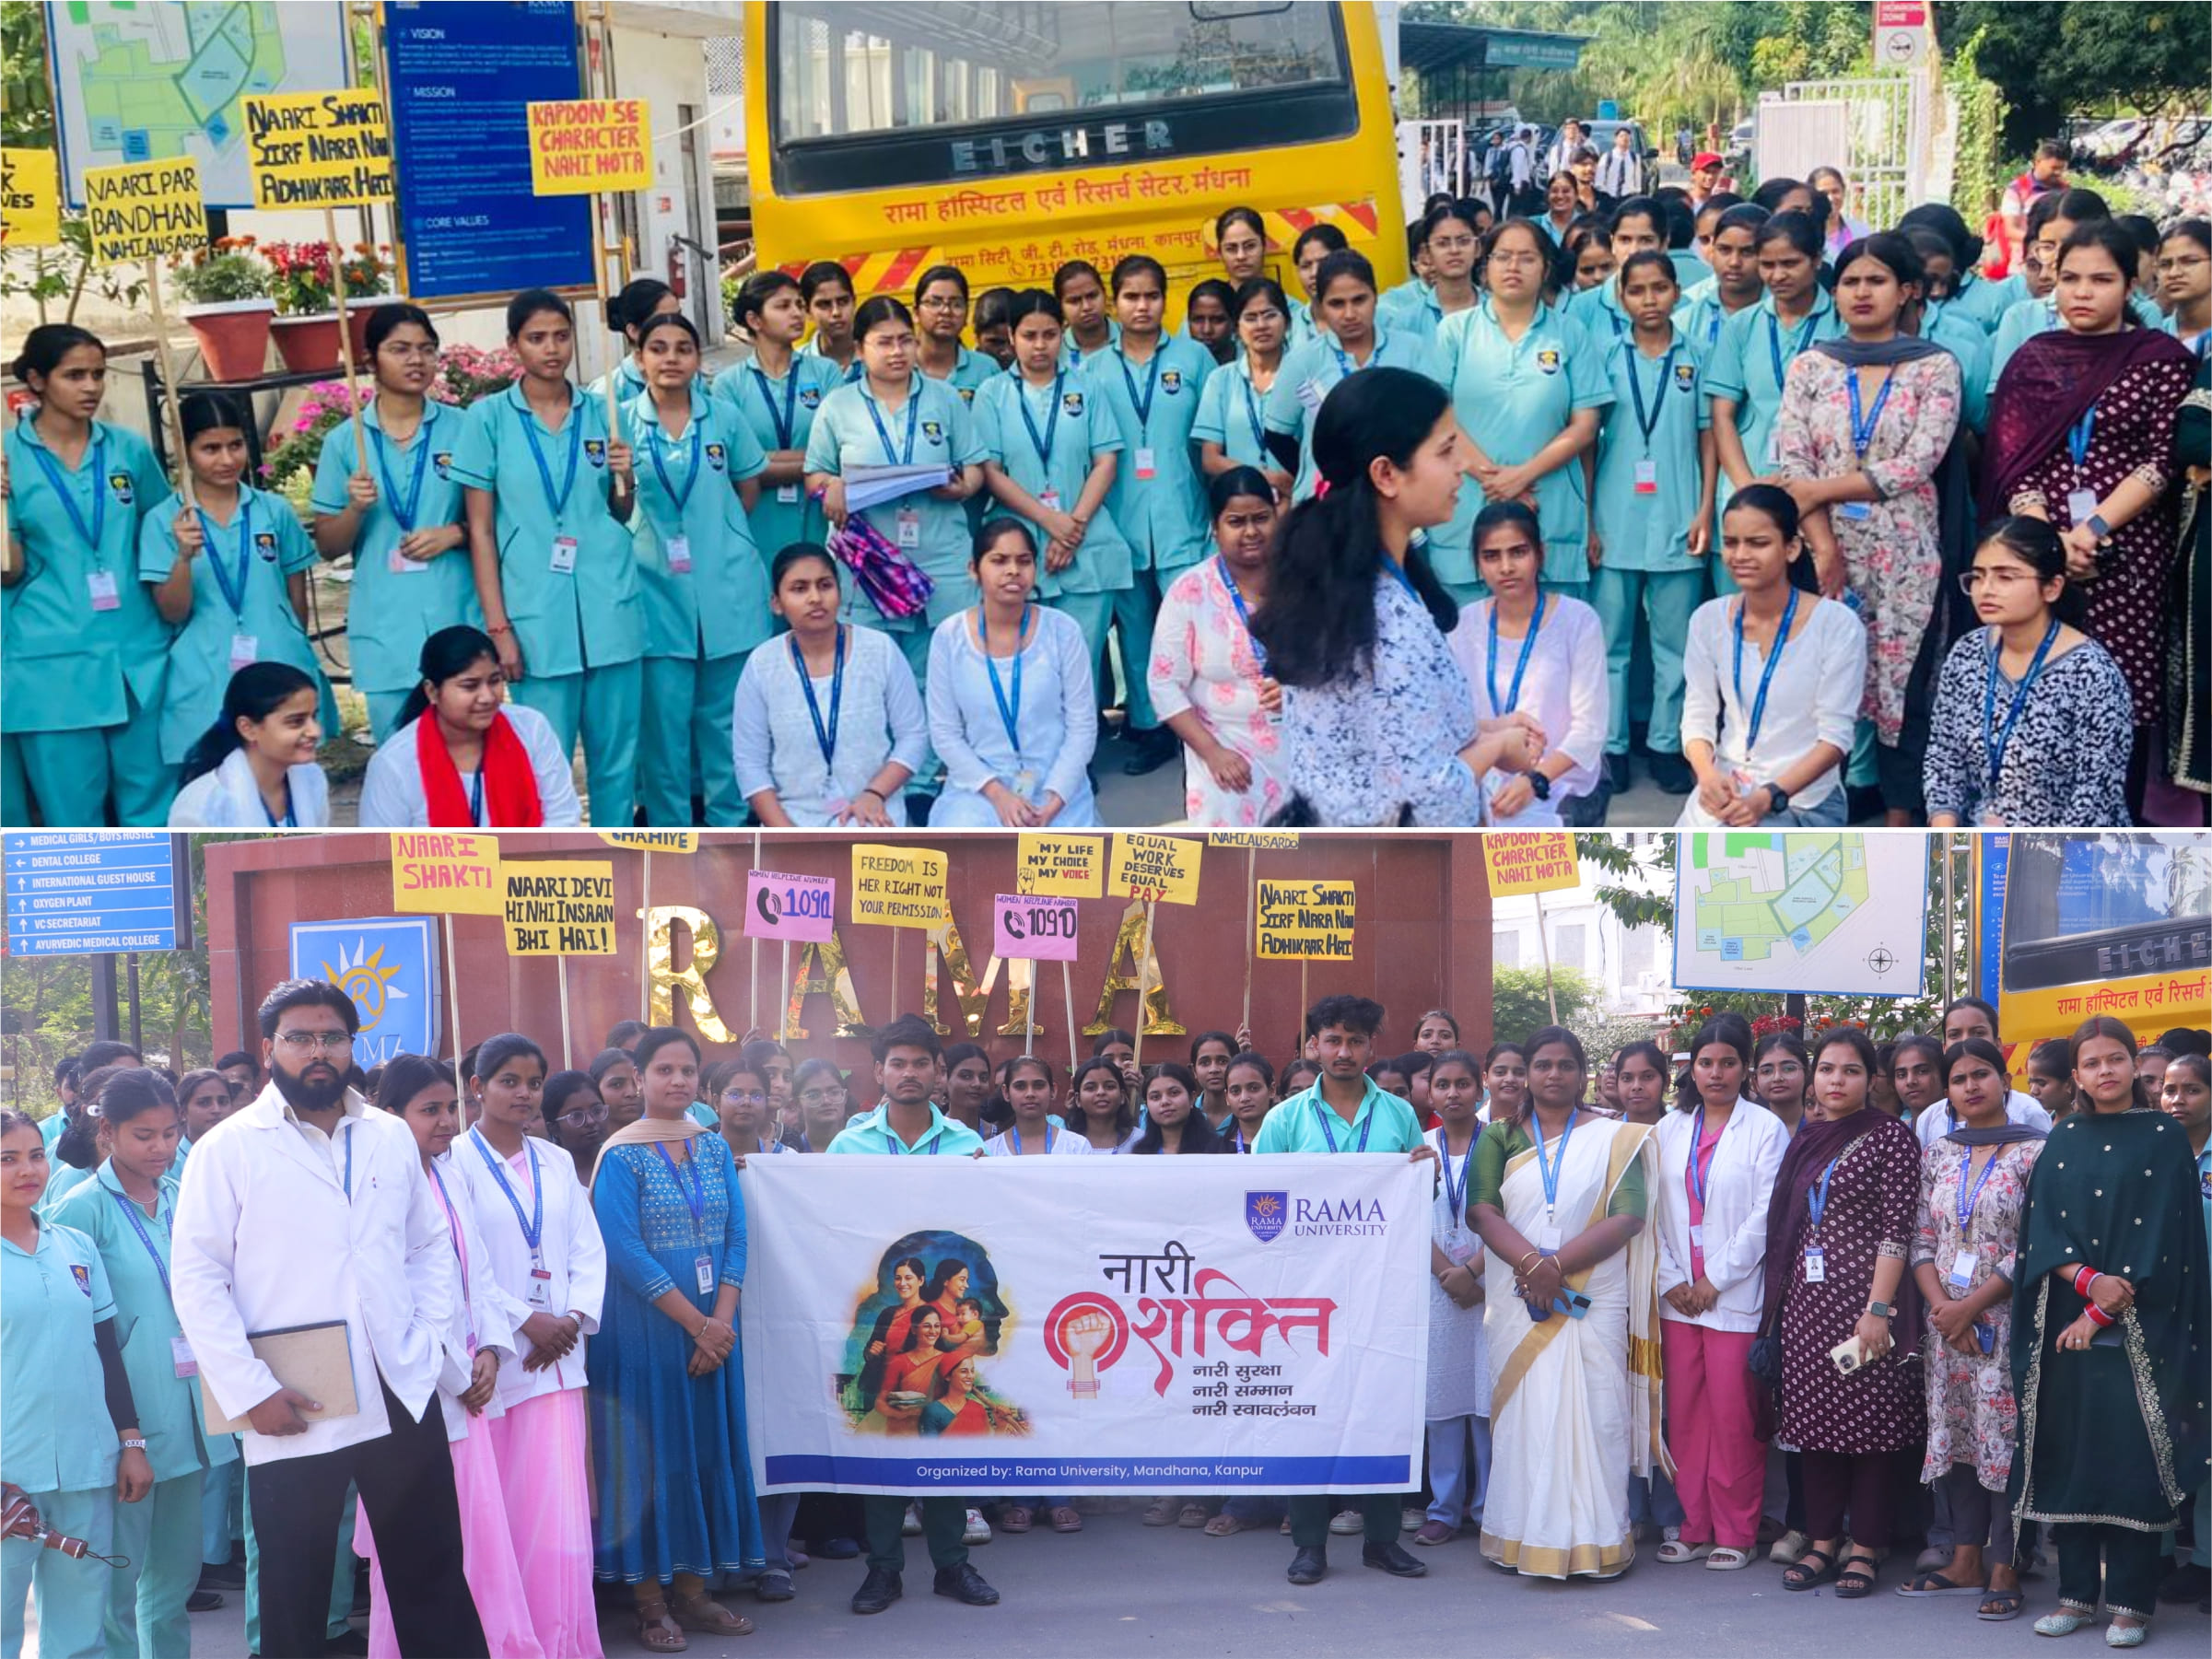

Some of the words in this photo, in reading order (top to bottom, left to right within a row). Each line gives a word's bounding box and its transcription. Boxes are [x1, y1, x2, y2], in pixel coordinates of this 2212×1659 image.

[411, 28, 445, 39] VISION
[414, 87, 456, 98] MISSION
[246, 99, 319, 133] NAARI
[533, 102, 605, 126] KAPDON
[614, 101, 639, 123] SE
[540, 126, 639, 152] CHARACTER
[951, 120, 1175, 171] EICHER
[544, 154, 591, 178] NAHI
[595, 151, 645, 175] HOTA
[86, 172, 158, 203] NAARI
[160, 167, 198, 194] PAR
[884, 201, 928, 225] रामा
[1036, 181, 1069, 211] एवं
[1075, 173, 1132, 204] रिसर्च
[91, 201, 202, 237] BANDHAN
[426, 217, 452, 228] CORE
[454, 216, 489, 227] VALUES
[30, 834, 68, 847] MEDICAL
[397, 835, 479, 859] NAARI
[1067, 845, 1094, 855] LIFE
[32, 855, 63, 868] DENTAL
[64, 853, 101, 866] COLLEGE
[1028, 855, 1047, 865] MY
[1053, 857, 1089, 867] CHOICE
[1132, 848, 1176, 867] WORK
[1492, 843, 1568, 867] CHARACTER
[403, 863, 492, 889] SHAKTI
[861, 857, 914, 874] FREEDOM
[922, 861, 938, 877] IS
[1038, 869, 1058, 879] MY
[1124, 861, 1185, 879] DESERVES
[1497, 866, 1533, 884] NAHI
[1536, 860, 1573, 880] HOTA
[32, 875, 97, 889] INTERNATIONAL
[97, 873, 127, 885] GUEST
[127, 871, 156, 883] HOUSE
[508, 876, 568, 898] NAARI
[570, 877, 613, 898] DEVI
[859, 878, 880, 893] HER
[884, 880, 922, 896] RIGHT
[923, 884, 943, 898] NOT
[1121, 872, 1168, 889] EQUAL
[33, 897, 65, 909] OXYGEN
[66, 896, 92, 907] PLANT
[1260, 883, 1307, 905] NAARI
[859, 899, 884, 915] YOUR
[887, 902, 942, 919] PERMISSION
[34, 918, 47, 929] VC
[47, 917, 101, 929] SECRETARIAT
[35, 938, 82, 951] AYURVEDIC
[82, 936, 122, 949] MEDICAL
[122, 934, 160, 947] COLLEGE
[514, 928, 550, 951] BHI
[2057, 998, 2081, 1015] रामा
[2086, 988, 2138, 1013] हॉस्पिटल
[2144, 981, 2163, 1008] एवं
[2169, 976, 2206, 1002] रिसर्च
[1295, 1198, 1387, 1222] RAMA
[1251, 1217, 1282, 1225] RAMA
[1295, 1224, 1387, 1236] UNIVERSITY
[1099, 1240, 1196, 1294] नारी
[1130, 1268, 1339, 1398] शक्ति
[1193, 1361, 1229, 1377] नारी
[1235, 1364, 1282, 1382] सुरक्षा
[1193, 1382, 1228, 1398] नारी
[1234, 1384, 1294, 1397] सम्मान
[1192, 1401, 1227, 1417] नारी
[1233, 1400, 1317, 1417] स्वावलंबन
[917, 1464, 989, 1479] Organized
[991, 1464, 1012, 1478] by:
[1015, 1465, 1057, 1477] Rama
[1059, 1465, 1130, 1478] University,
[1133, 1465, 1211, 1478] Mandhana,
[1214, 1464, 1265, 1478] Kanpur
